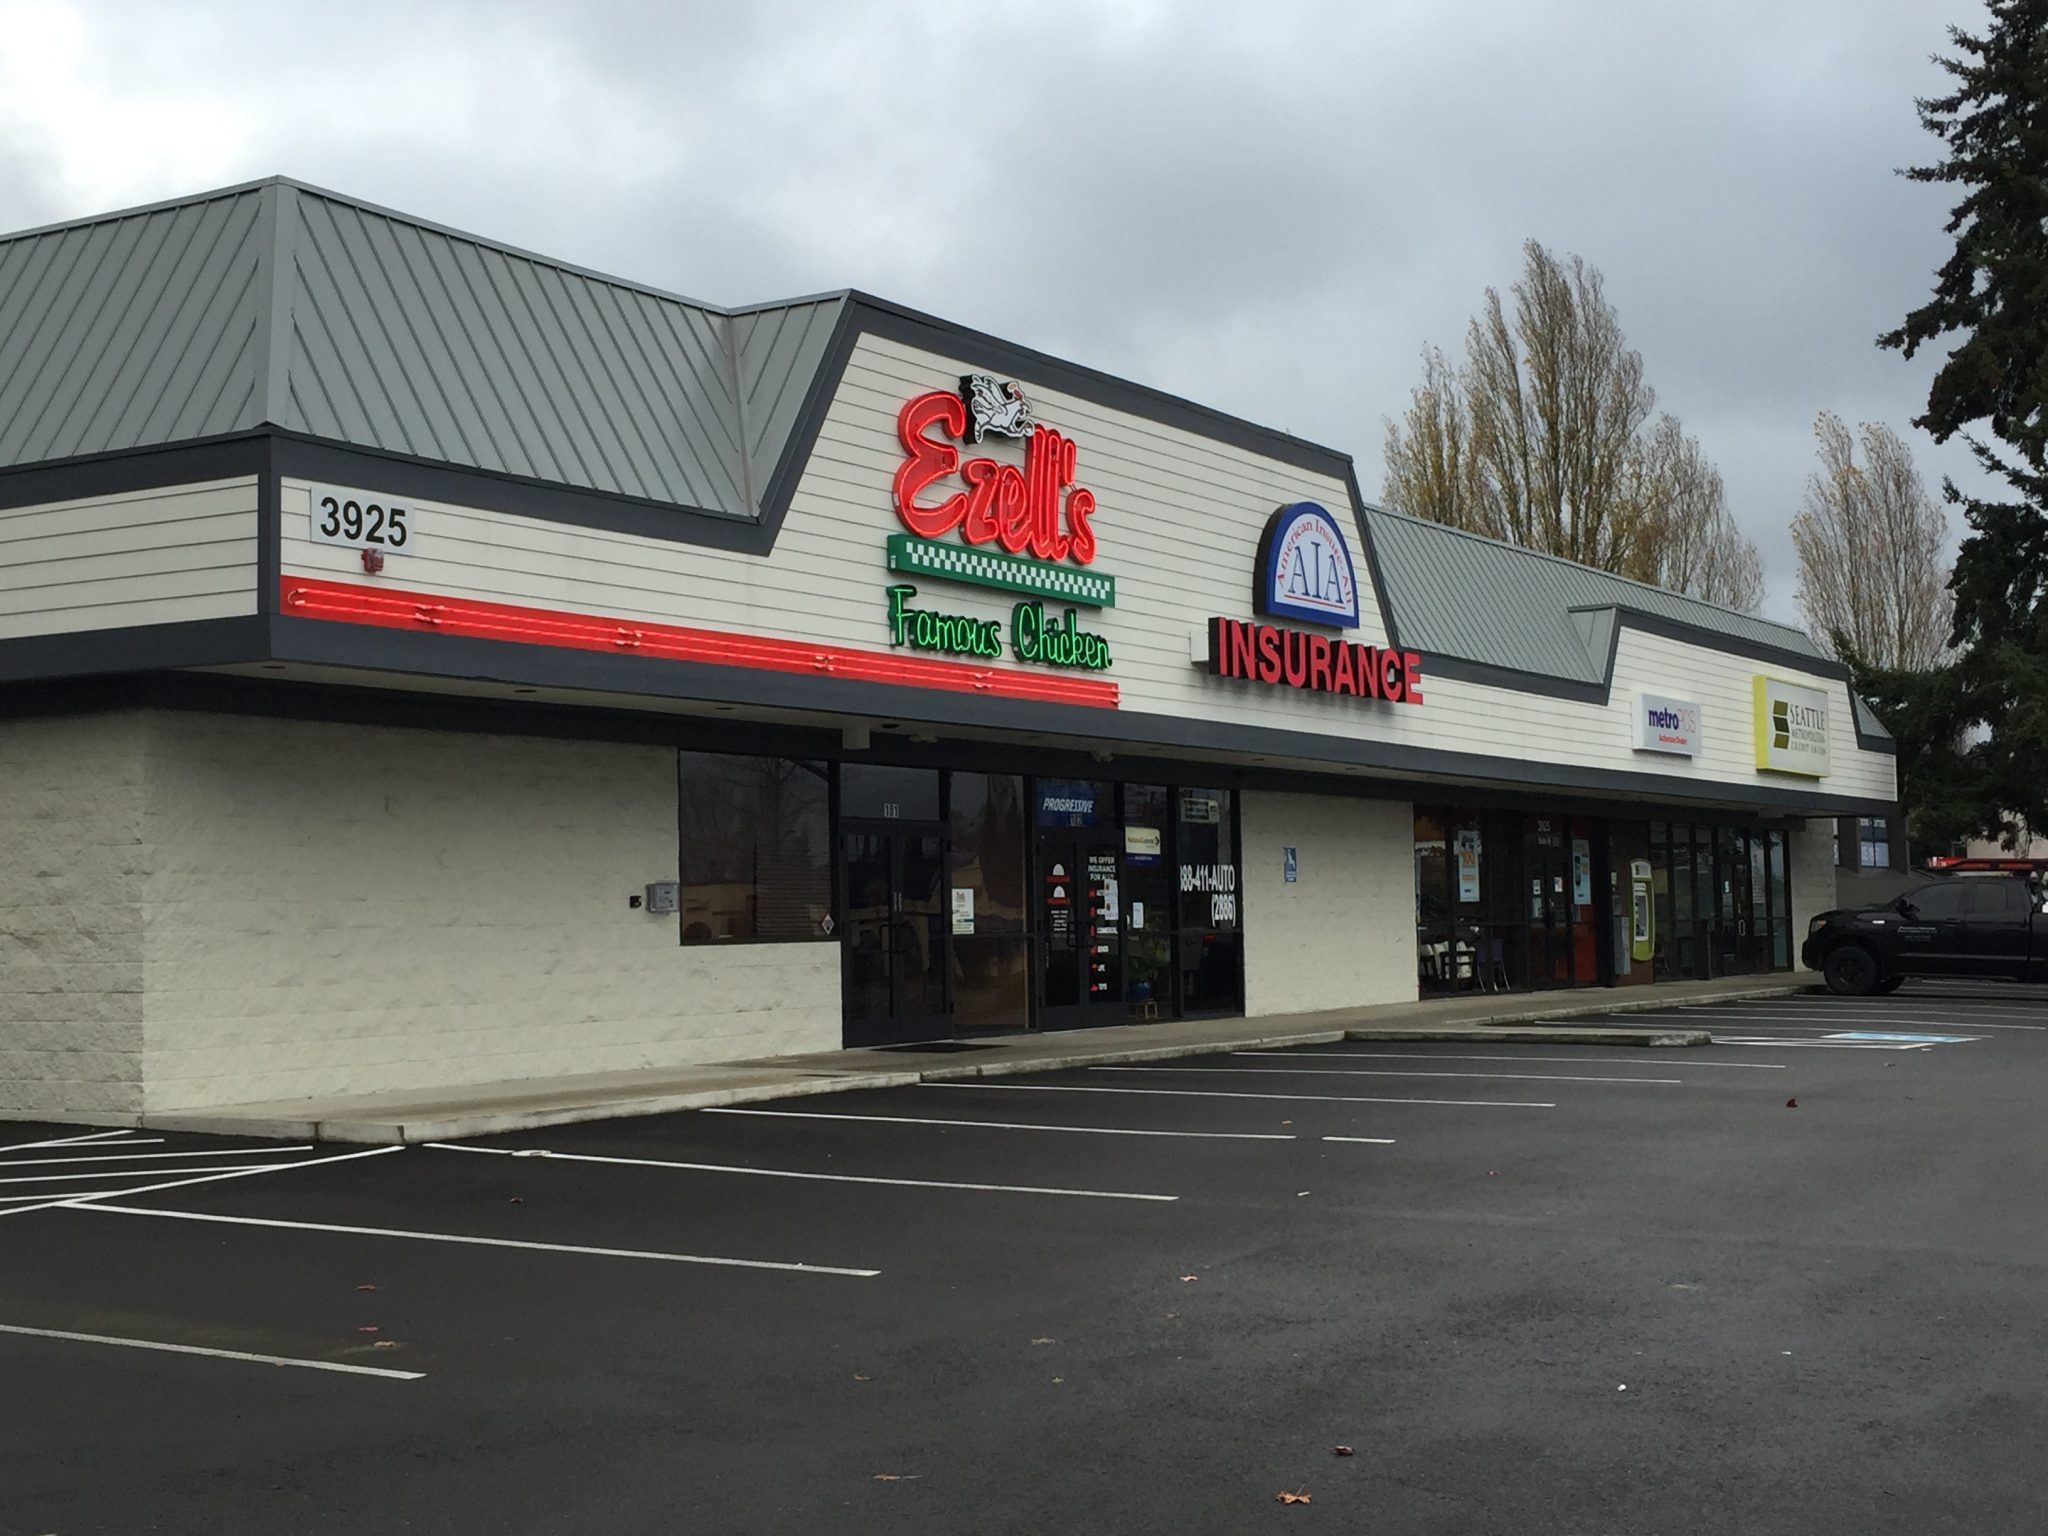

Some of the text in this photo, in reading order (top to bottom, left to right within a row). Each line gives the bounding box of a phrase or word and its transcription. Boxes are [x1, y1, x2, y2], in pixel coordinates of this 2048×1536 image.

[893, 391, 1096, 566] Ezell's
[320, 496, 407, 547] 3925
[1276, 520, 1313, 589] American
[1288, 541, 1344, 604] AIA
[888, 585, 1112, 668] Famous Chicken
[1218, 616, 1424, 705] INSURANCE
[1648, 707, 1697, 735] metroPCS
[1790, 704, 1825, 731] SEATTLE
[1042, 797, 1095, 813] PROGRESSIVE
